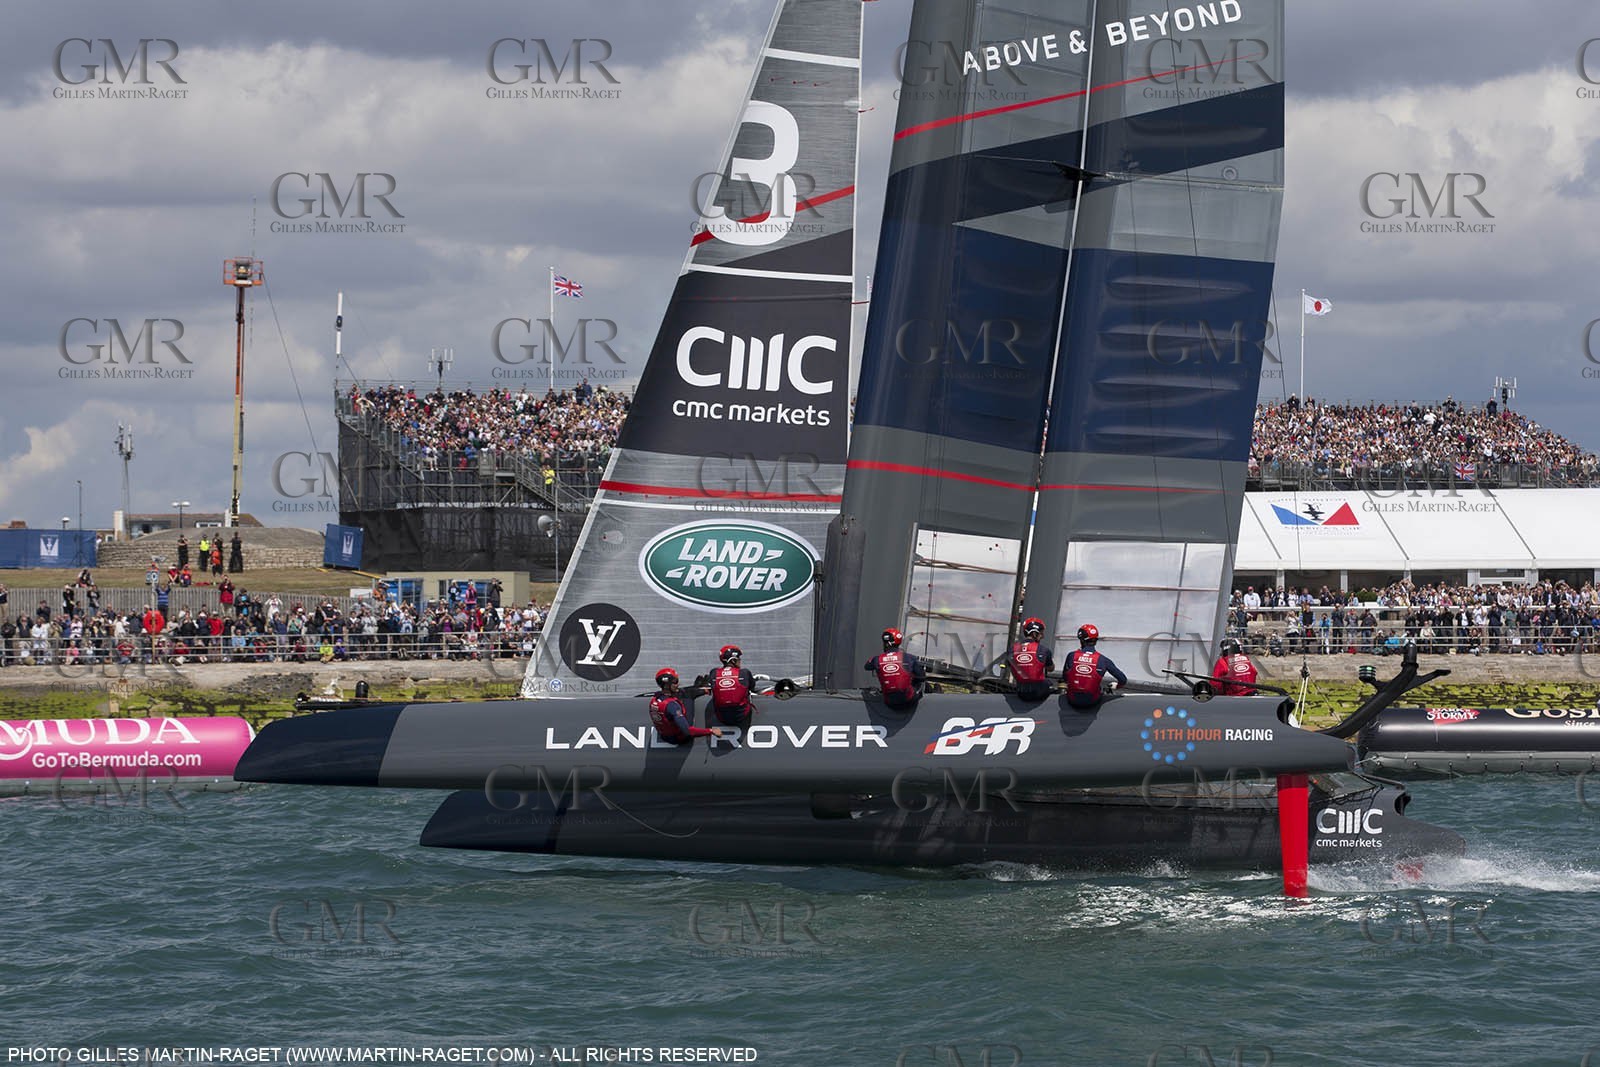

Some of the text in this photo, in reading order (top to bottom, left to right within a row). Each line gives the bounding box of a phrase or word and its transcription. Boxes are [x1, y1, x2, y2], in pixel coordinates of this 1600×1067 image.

[963, 0, 1242, 76] ABOVE & BEYOND
[702, 100, 799, 246] 3
[672, 400, 831, 427] cmc markets
[677, 537, 765, 564] LAND
[682, 565, 788, 592] ROVER
[1153, 728, 1274, 742] 11TH HOUR RACING
[1563, 719, 1596, 728] Since
[711, 725, 889, 749] ROVER
[32, 751, 202, 769] GoToBermuda.com
[1316, 837, 1383, 848] cmc markets
